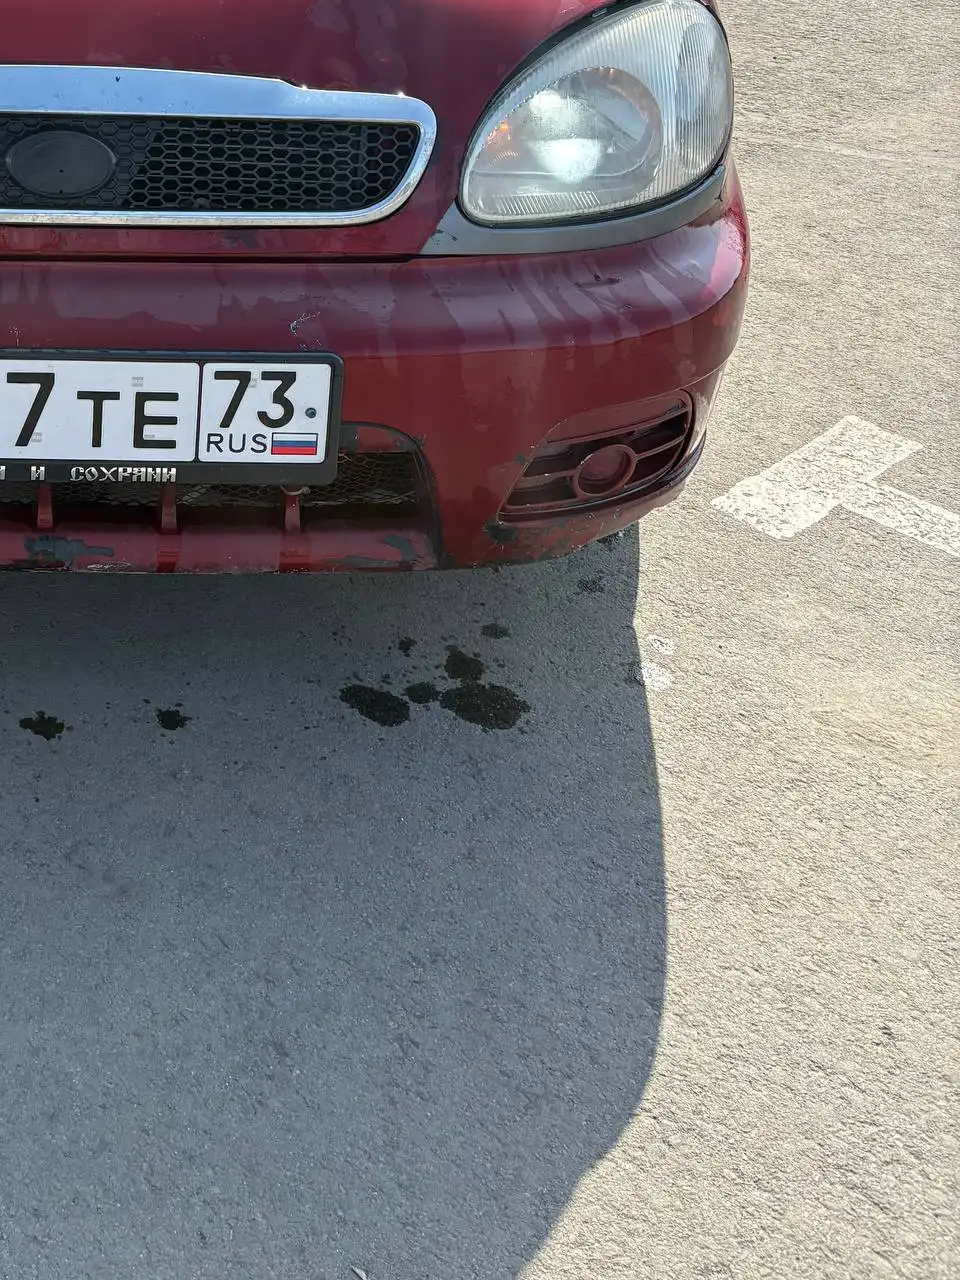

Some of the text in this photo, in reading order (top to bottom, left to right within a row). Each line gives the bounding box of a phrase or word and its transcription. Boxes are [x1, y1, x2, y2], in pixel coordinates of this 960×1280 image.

[214, 370, 297, 429] 73
[206, 433, 268, 453] RUS
[30, 465, 46, 481] И
[70, 466, 177, 483] СОХРАНИ
